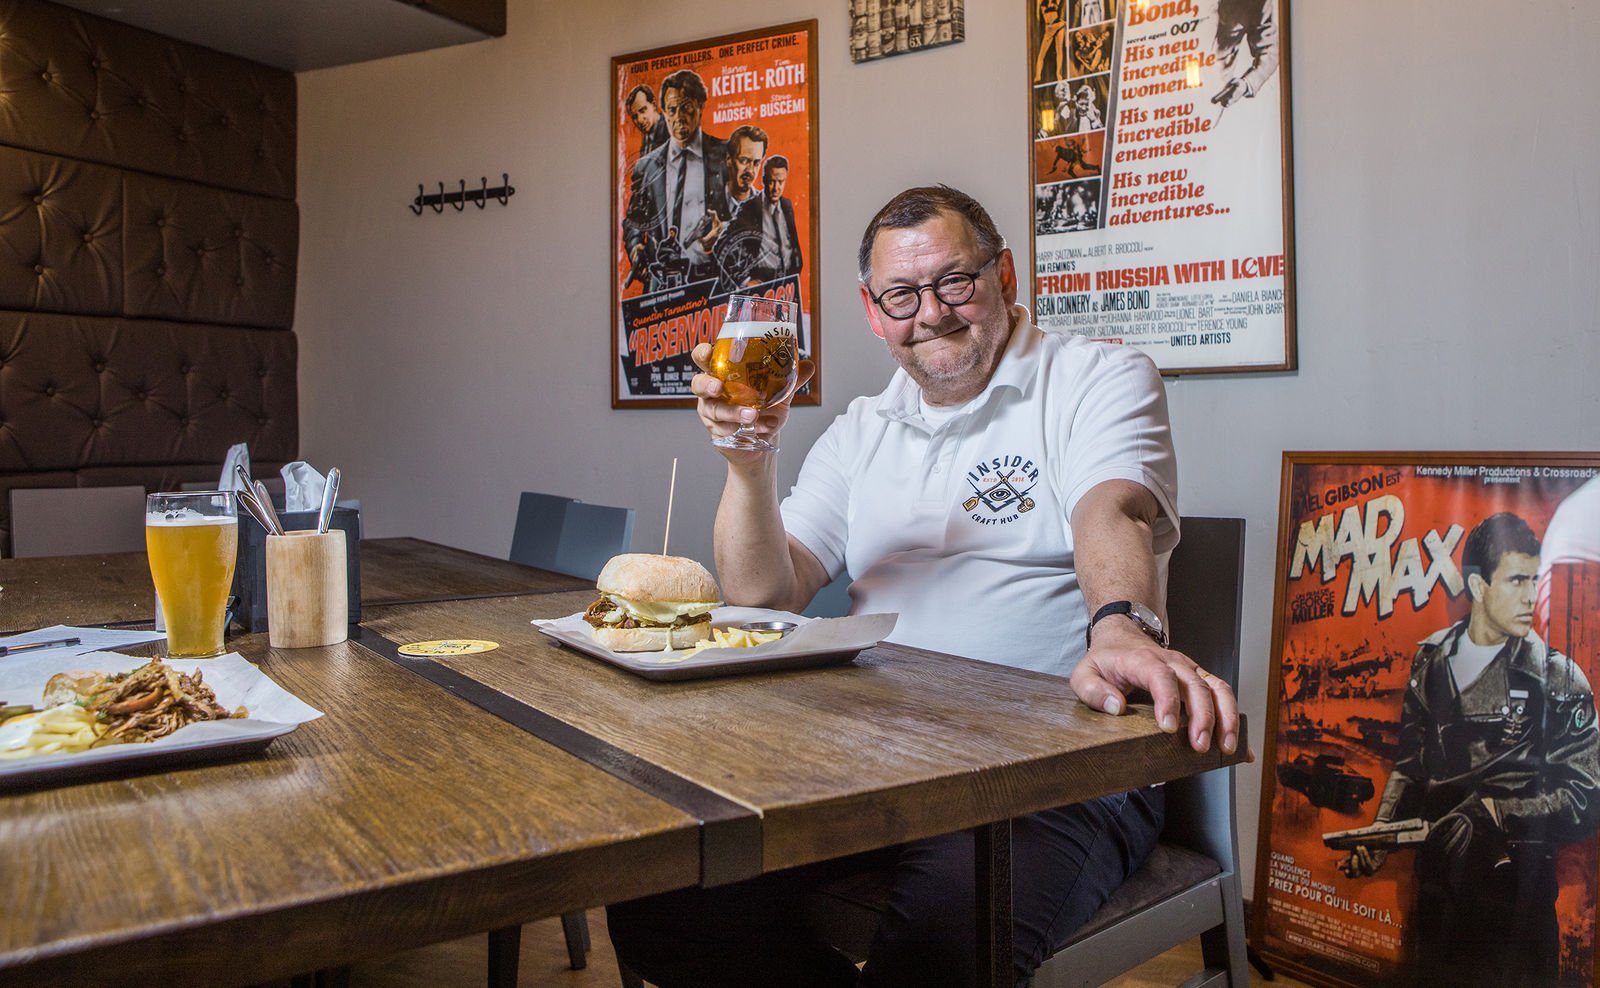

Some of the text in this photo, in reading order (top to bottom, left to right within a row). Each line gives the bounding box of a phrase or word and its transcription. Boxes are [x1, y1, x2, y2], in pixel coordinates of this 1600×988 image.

[1170, 20, 1200, 36] 007
[651, 56, 681, 70] PERFECT
[683, 50, 714, 64] KILLERS.
[719, 46, 734, 58] ONE
[736, 40, 769, 55] PERFECT
[772, 35, 799, 49] CRIME.
[1124, 38, 1199, 64] His new
[712, 63, 805, 97] KEITEL ROTH
[713, 98, 805, 124] MADSEN BUSCEMI
[1119, 103, 1194, 126] His new
[1117, 117, 1212, 144] incredible
[1115, 140, 1207, 163] enemies...
[1112, 168, 1187, 189] His new
[1111, 183, 1205, 208] incredible
[1109, 202, 1230, 226] adventures...
[1037, 272, 1091, 295] FROM
[1096, 265, 1170, 290] RUSSIA
[1174, 260, 1226, 284] WITH
[1047, 260, 1076, 273] FLEMING'S
[1037, 296, 1055, 316] SEAN
[1057, 294, 1091, 314] CONNERY
[1101, 291, 1125, 311] JAMES
[1127, 290, 1150, 310] BOND
[760, 327, 794, 344] INSID
[1171, 332, 1231, 346] UNITED ARTISTS
[968, 455, 1039, 482] INSIDER
[1416, 465, 1453, 478] Kennedy
[1454, 466, 1478, 477] Miller
[1479, 466, 1532, 478] Productions
[1533, 467, 1540, 477] &
[1325, 473, 1384, 506] GIBSON
[1385, 473, 1401, 487] EST
[971, 513, 1019, 525] CRAFT HUB
[1289, 494, 1405, 585] MAD
[1341, 523, 1465, 621] MAX
[1291, 590, 1335, 610] GEORGE
[1291, 603, 1335, 625] MILLER
[1270, 851, 1295, 865] QUAND
[1280, 862, 1312, 878] VIOLENCE
[1269, 876, 1294, 893] PRIEZ
[1295, 884, 1322, 902] POUR
[1325, 894, 1350, 912] QU'IL
[1353, 902, 1377, 919] SOIT
[1311, 881, 1336, 895] MONDE
